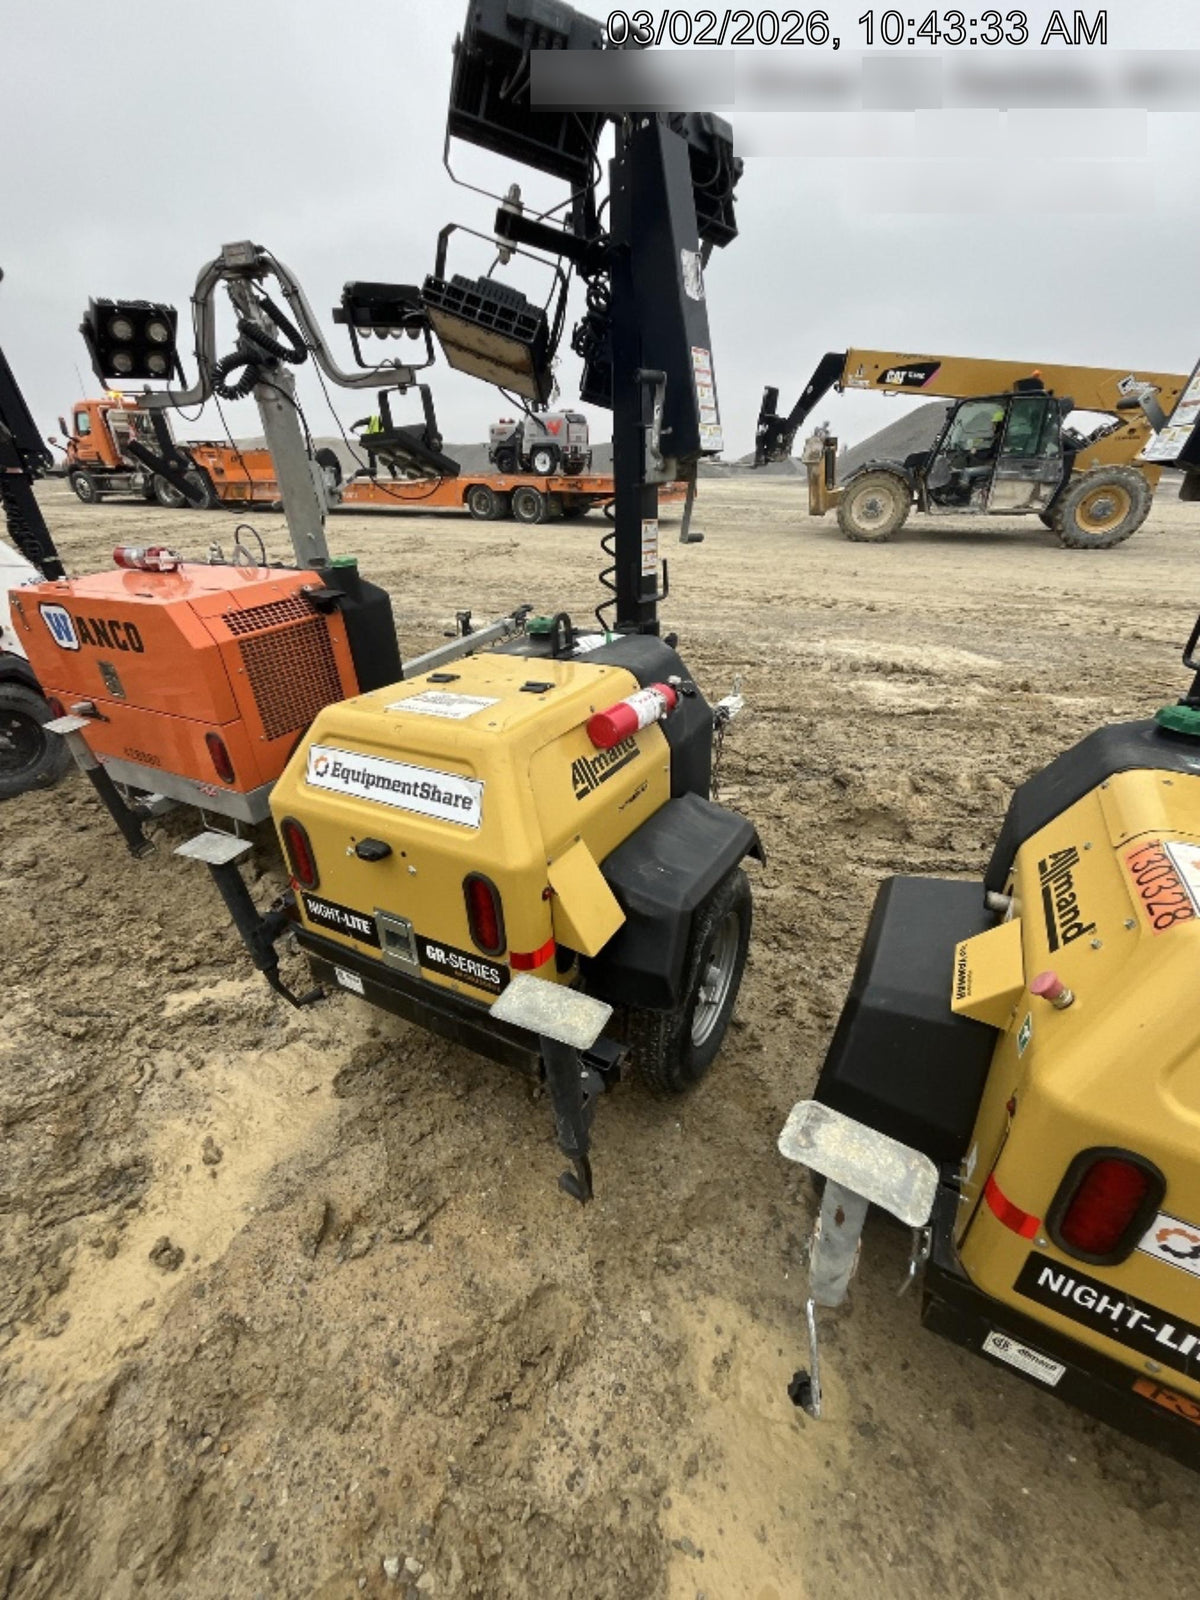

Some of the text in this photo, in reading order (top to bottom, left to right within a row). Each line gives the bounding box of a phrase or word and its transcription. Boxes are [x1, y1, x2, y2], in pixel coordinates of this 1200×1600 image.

[43, 611, 145, 653] WANCO
[330, 762, 474, 811] EquipmentShare
[306, 899, 372, 935] NIGHT-LITE
[1039, 846, 1097, 948] Allmand
[426, 945, 501, 984] GR-SERIES
